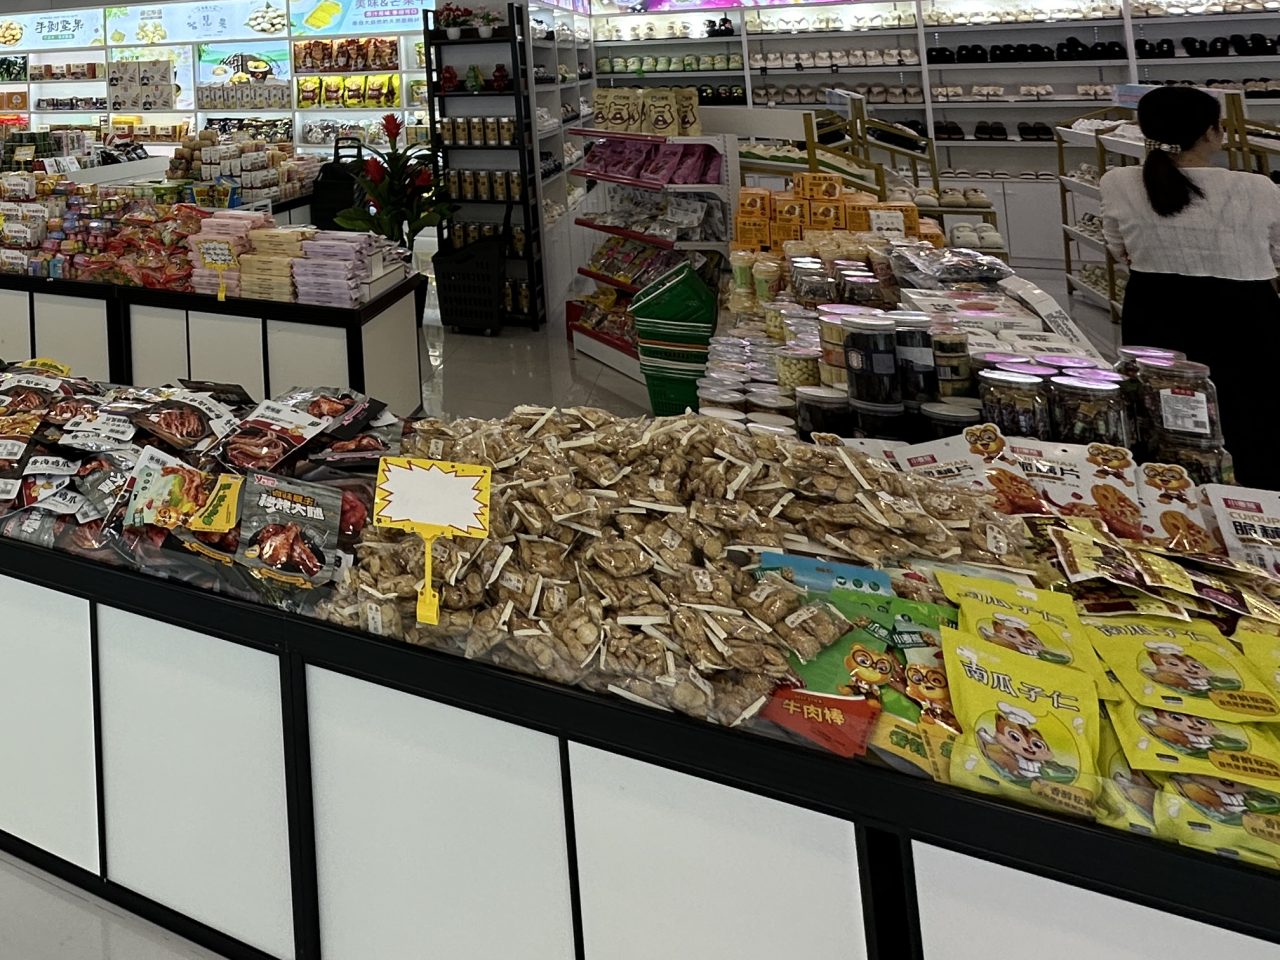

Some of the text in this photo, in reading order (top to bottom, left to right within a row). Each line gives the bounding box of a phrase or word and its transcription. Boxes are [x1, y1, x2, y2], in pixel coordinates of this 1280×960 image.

[35, 19, 84, 33] 手剥坚果
[960, 660, 1080, 712] 南瓜子仁
[783, 699, 845, 726] 牛肉棒
